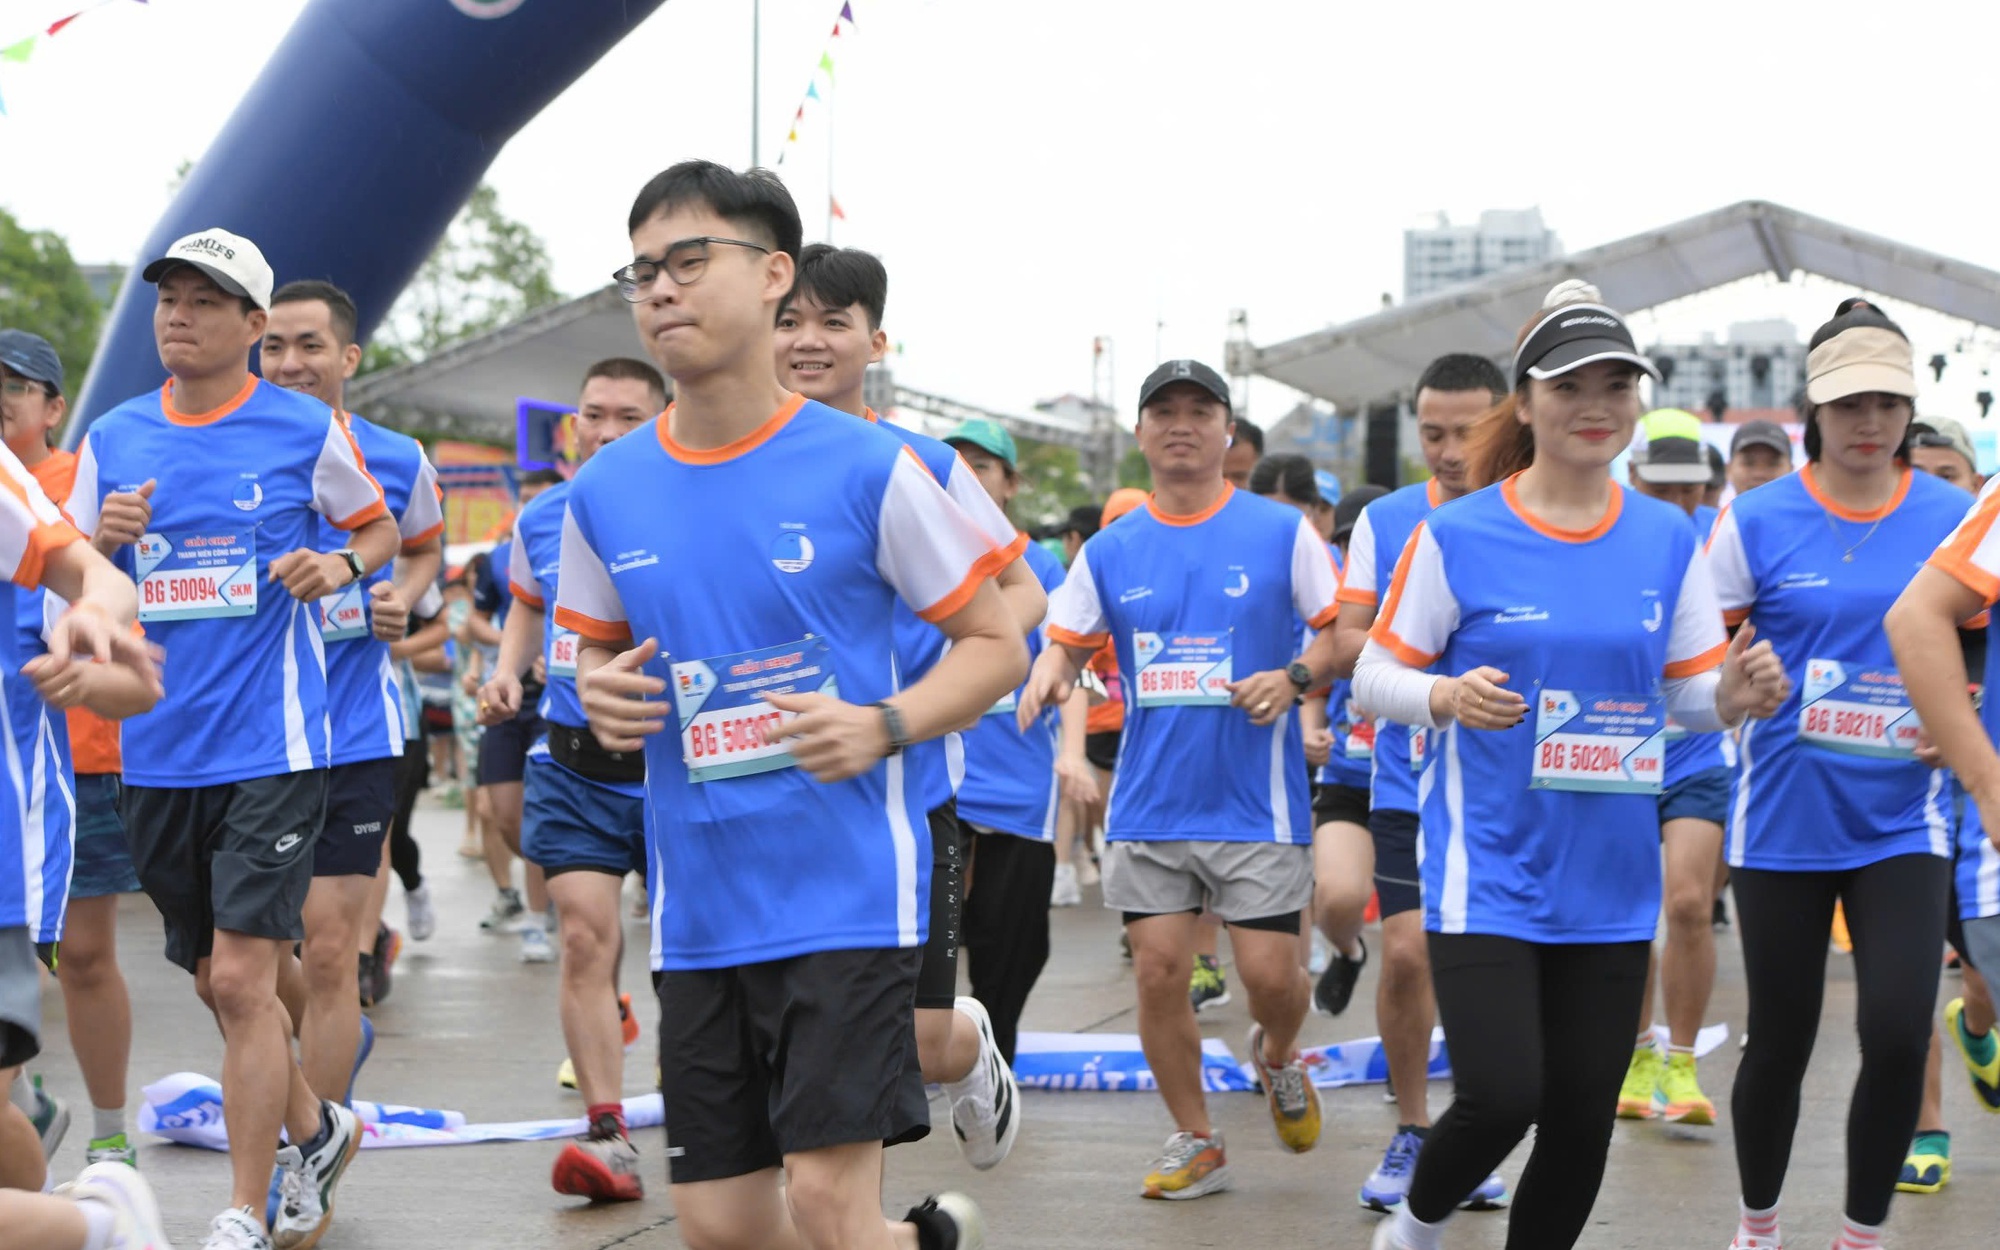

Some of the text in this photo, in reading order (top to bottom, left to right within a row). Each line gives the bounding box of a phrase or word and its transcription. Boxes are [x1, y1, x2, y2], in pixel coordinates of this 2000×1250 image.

[144, 577, 217, 604] BG 50094
[230, 583, 253, 597] 5KM
[338, 607, 360, 621] 5KM
[1142, 670, 1196, 691] BG 50195
[1805, 706, 1830, 733] BG
[690, 723, 717, 758] BG
[1541, 742, 1620, 772] BG 50204
[1634, 757, 1658, 772] 5KM
[947, 845, 956, 958] RUNING
